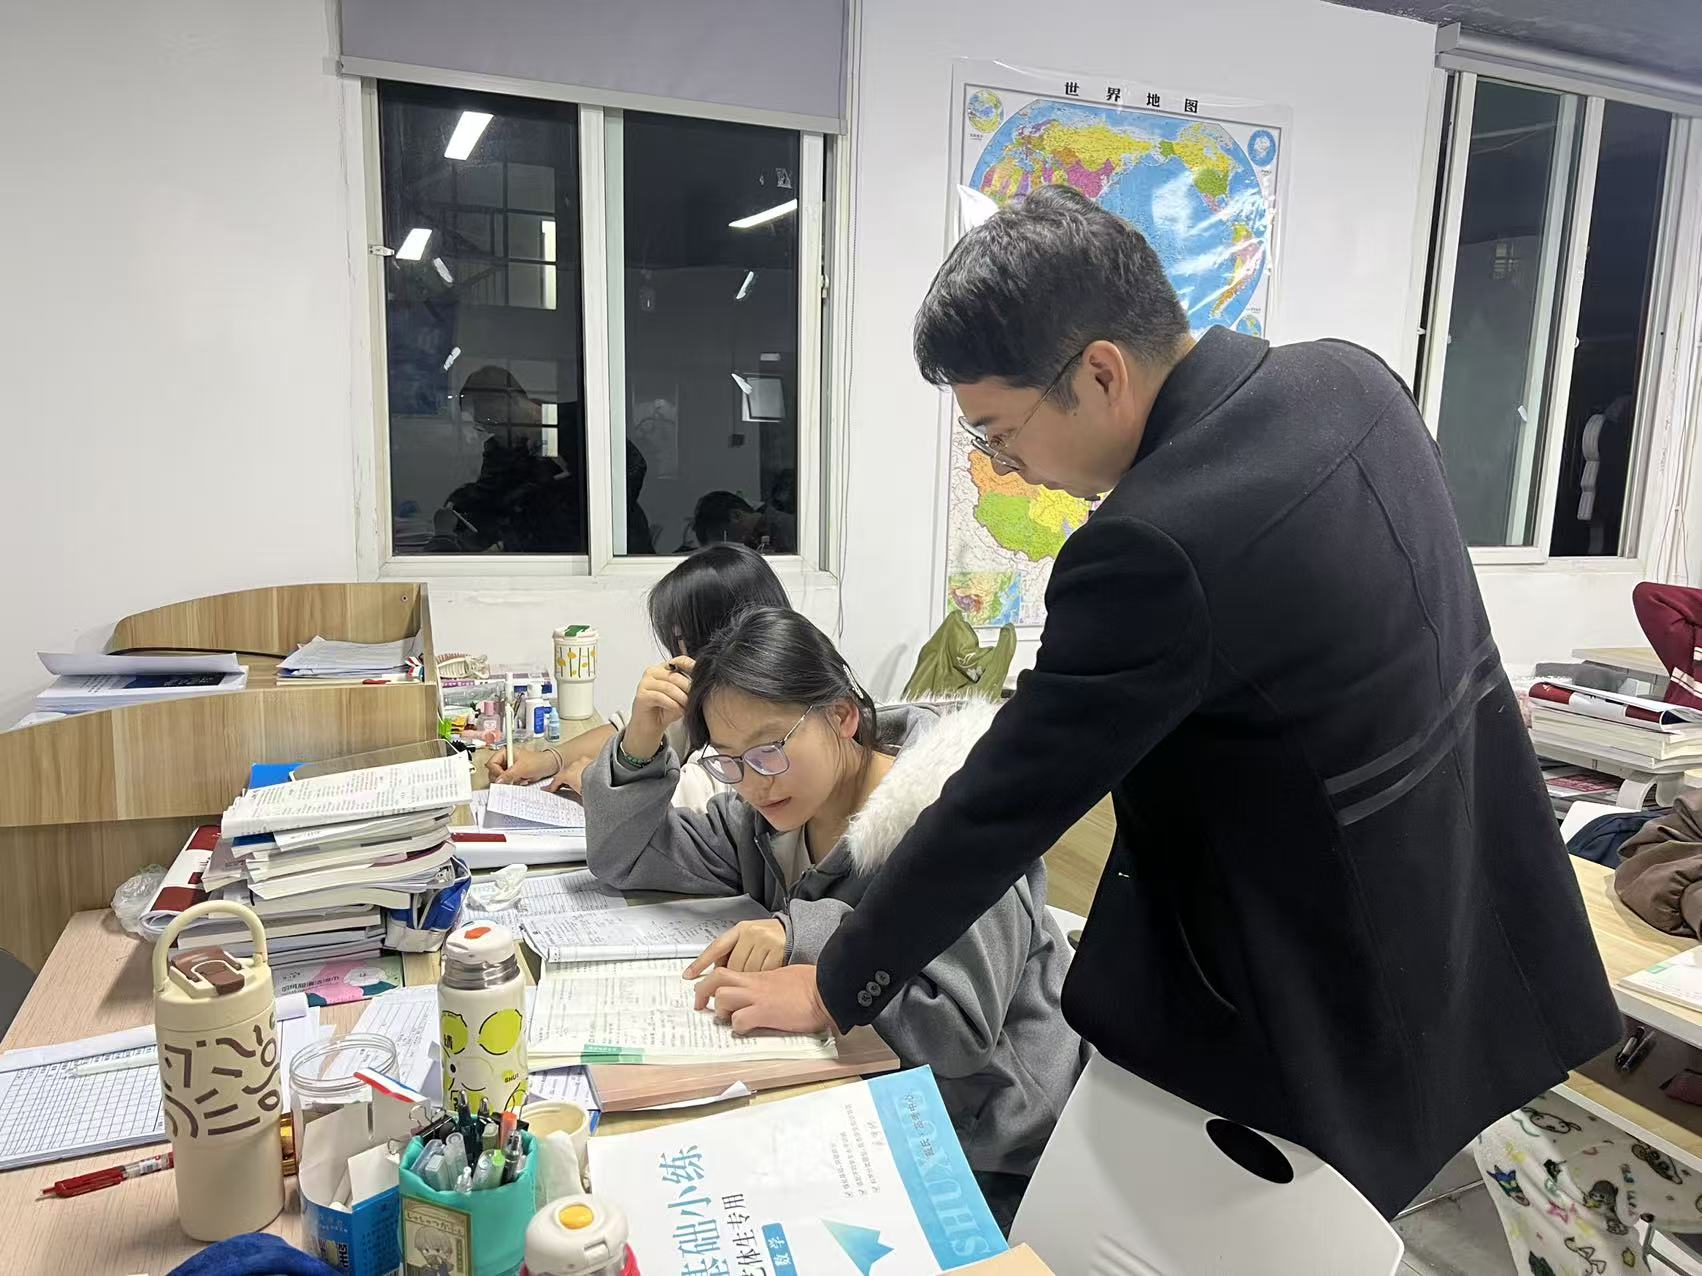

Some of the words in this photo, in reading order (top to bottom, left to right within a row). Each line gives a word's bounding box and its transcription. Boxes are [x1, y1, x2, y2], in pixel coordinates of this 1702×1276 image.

[1064, 81, 1199, 113] 世界地图
[767, 1236, 791, 1266] 数学
